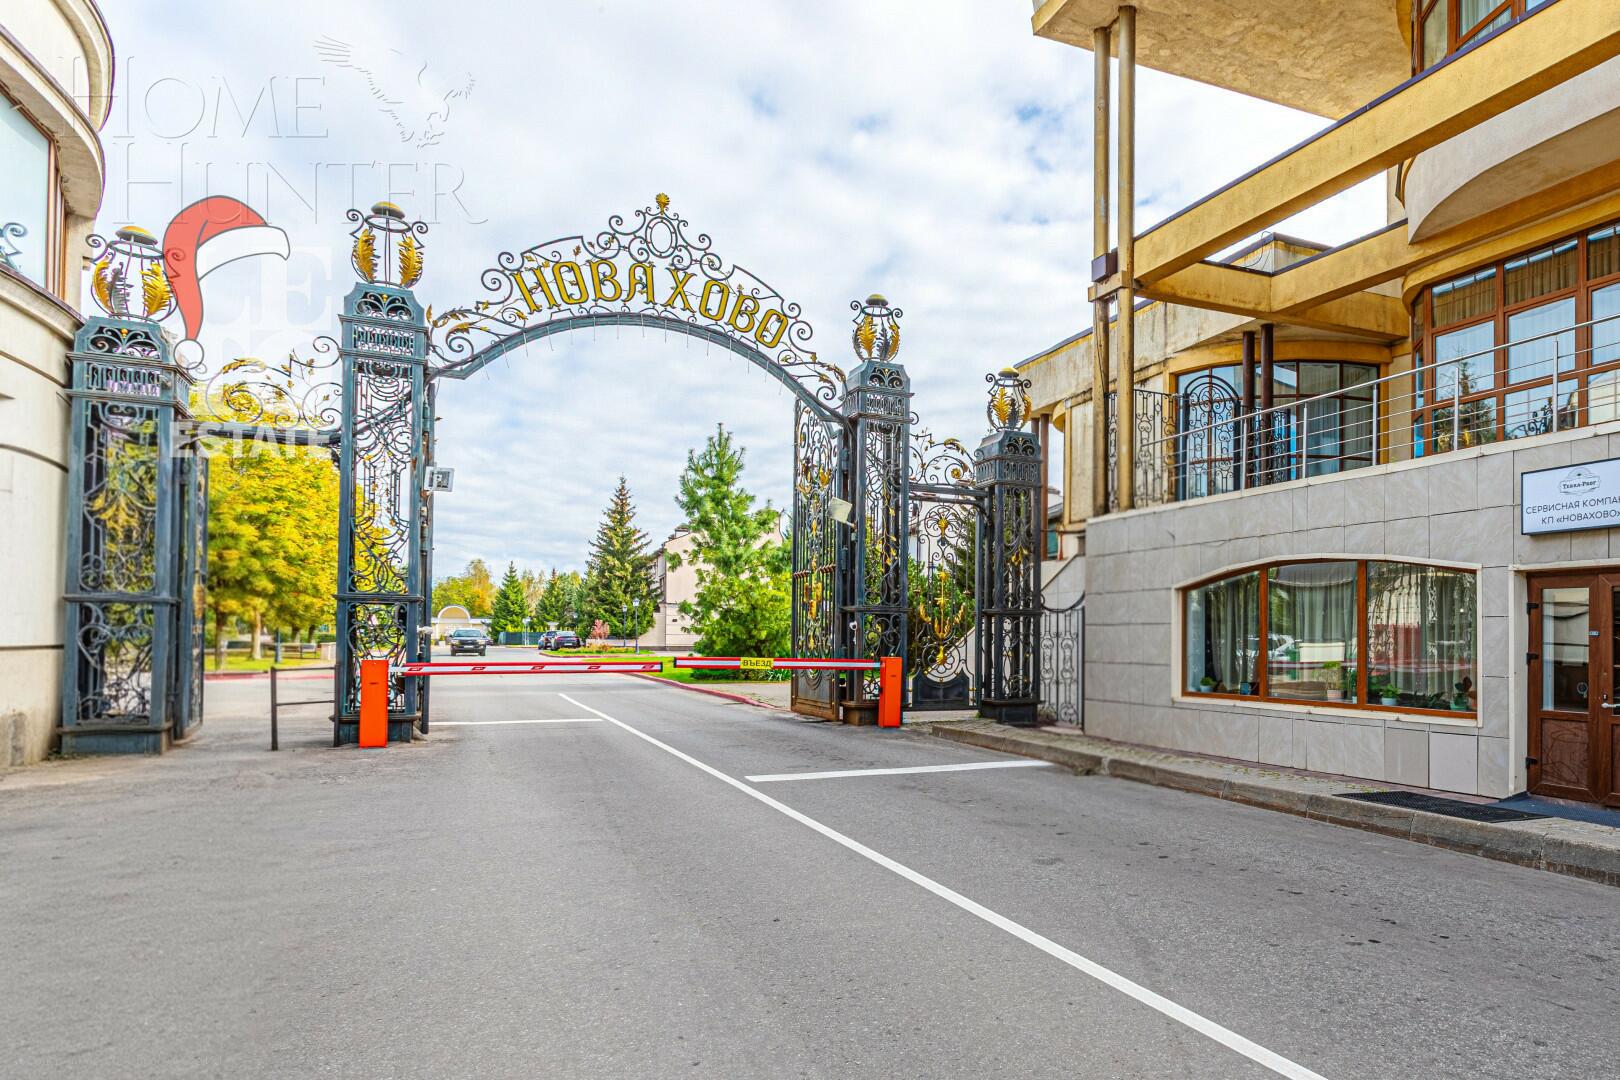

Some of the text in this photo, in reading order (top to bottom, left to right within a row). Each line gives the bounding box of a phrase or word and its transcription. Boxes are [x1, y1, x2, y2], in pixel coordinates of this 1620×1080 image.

[510, 259, 788, 349] НОВАХОВО
[1526, 500, 1580, 514] СЕРВИСНАЯ
[1541, 516, 1554, 525] КП
[743, 659, 772, 668] ВЪЕЗД
